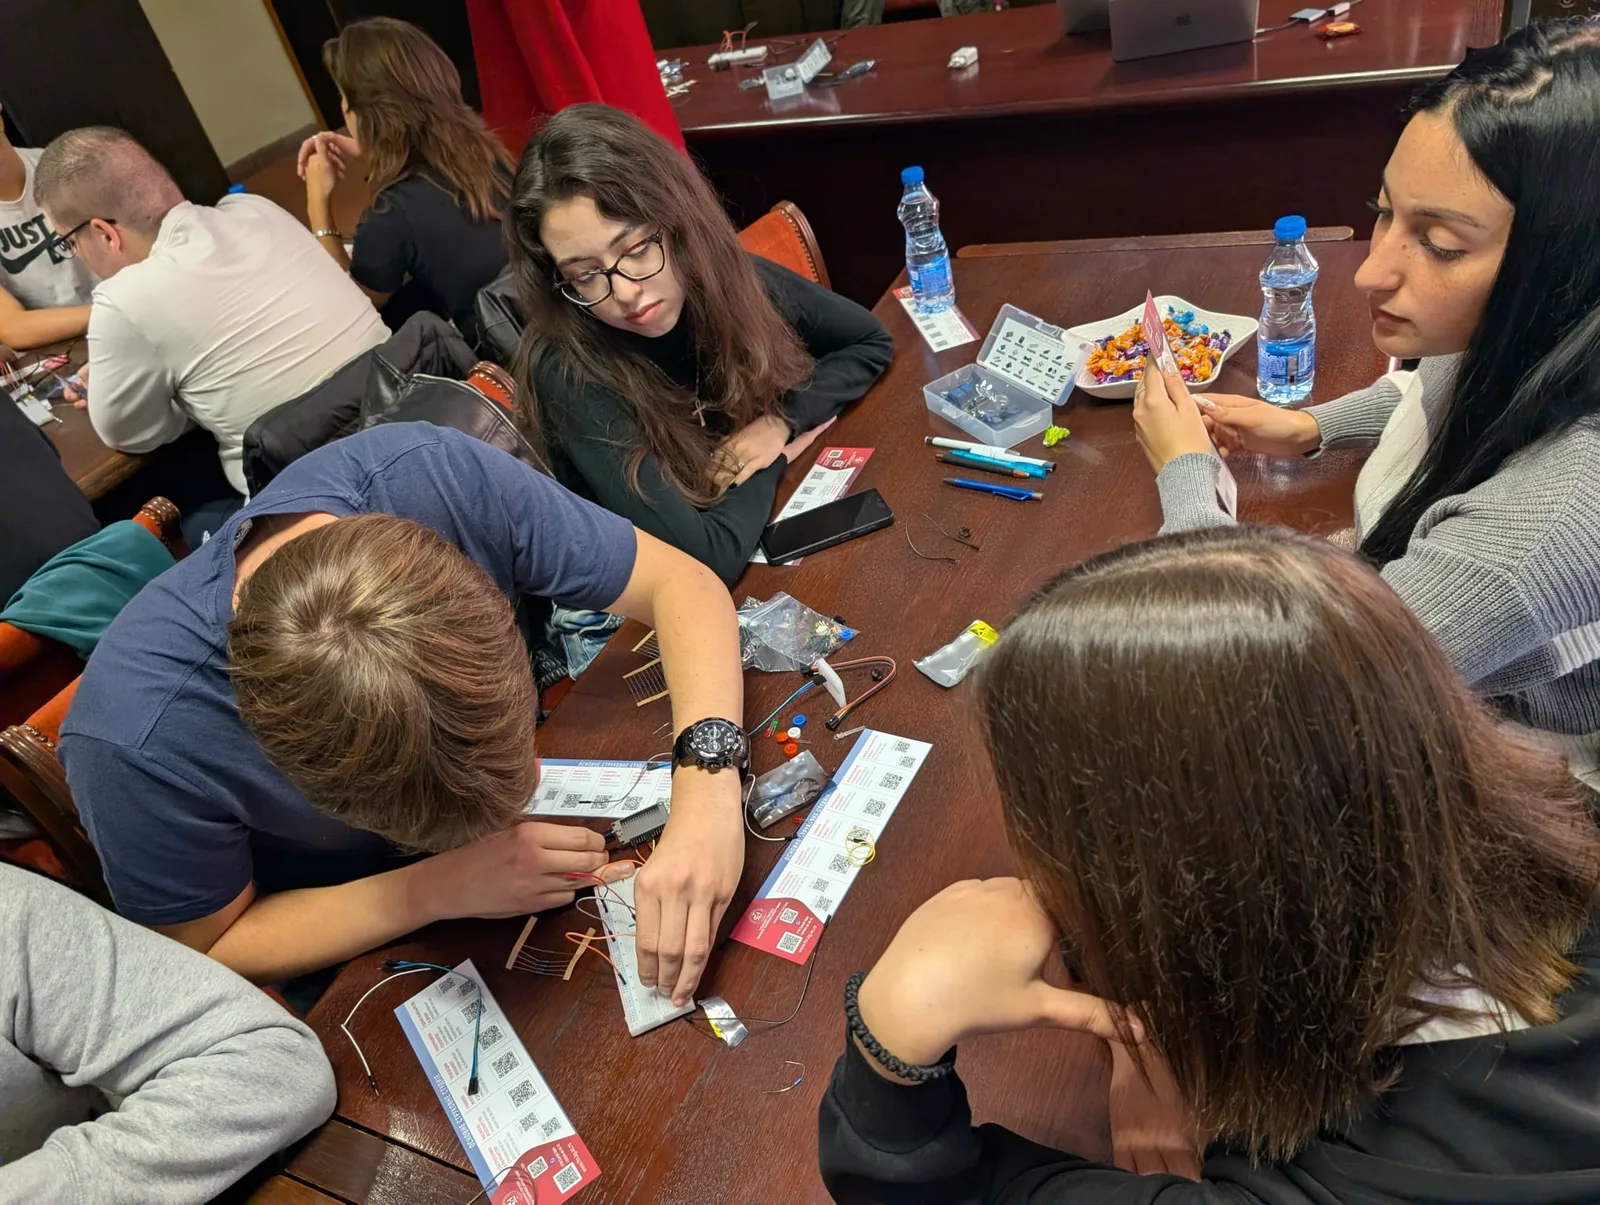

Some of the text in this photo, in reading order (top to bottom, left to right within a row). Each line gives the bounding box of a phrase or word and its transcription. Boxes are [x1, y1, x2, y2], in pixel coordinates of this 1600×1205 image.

[0, 213, 51, 253] JUST
[434, 1074, 450, 1095] СТУДИЈЕ
[444, 1095, 463, 1123] СТРУКОВНЕ
[458, 1122, 476, 1149] ОСНОВНЕ
